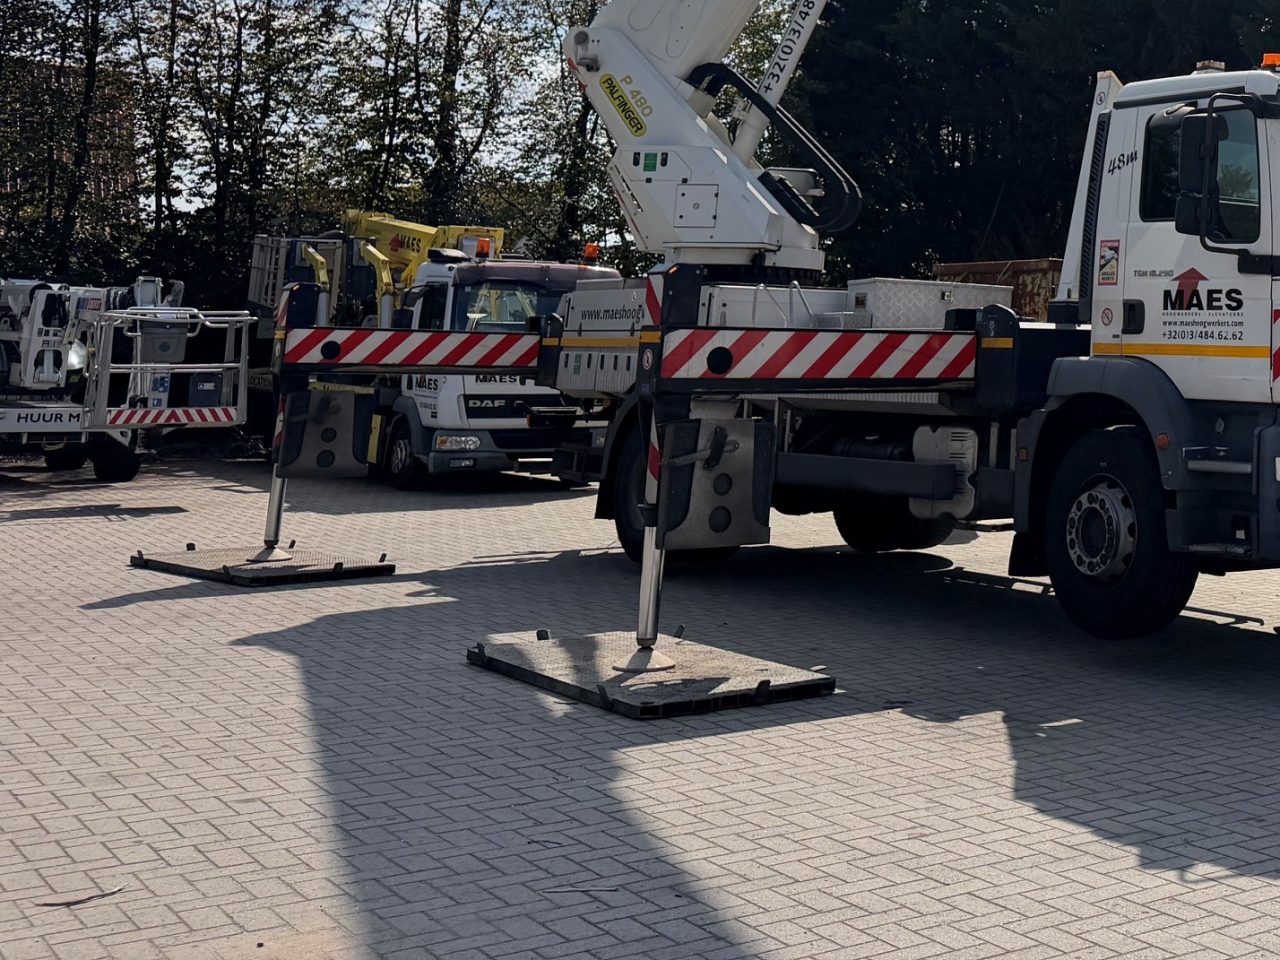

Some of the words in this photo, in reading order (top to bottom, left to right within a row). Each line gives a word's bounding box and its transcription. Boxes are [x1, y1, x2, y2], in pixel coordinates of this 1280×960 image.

[620, 74, 633, 85] P
[630, 89, 653, 118] 480
[602, 77, 644, 134] PALFINGER
[1107, 149, 1138, 176] 48m
[399, 235, 422, 254] MAES
[1163, 288, 1244, 311] MAES
[1162, 319, 1244, 328] www.maeshoogwerkers.com
[1162, 330, 1244, 341] +32(0)3/484.62.62
[415, 376, 439, 391] MAES
[475, 375, 518, 384] MAES
[468, 399, 507, 408] DAF
[16, 412, 64, 423] HUUR
